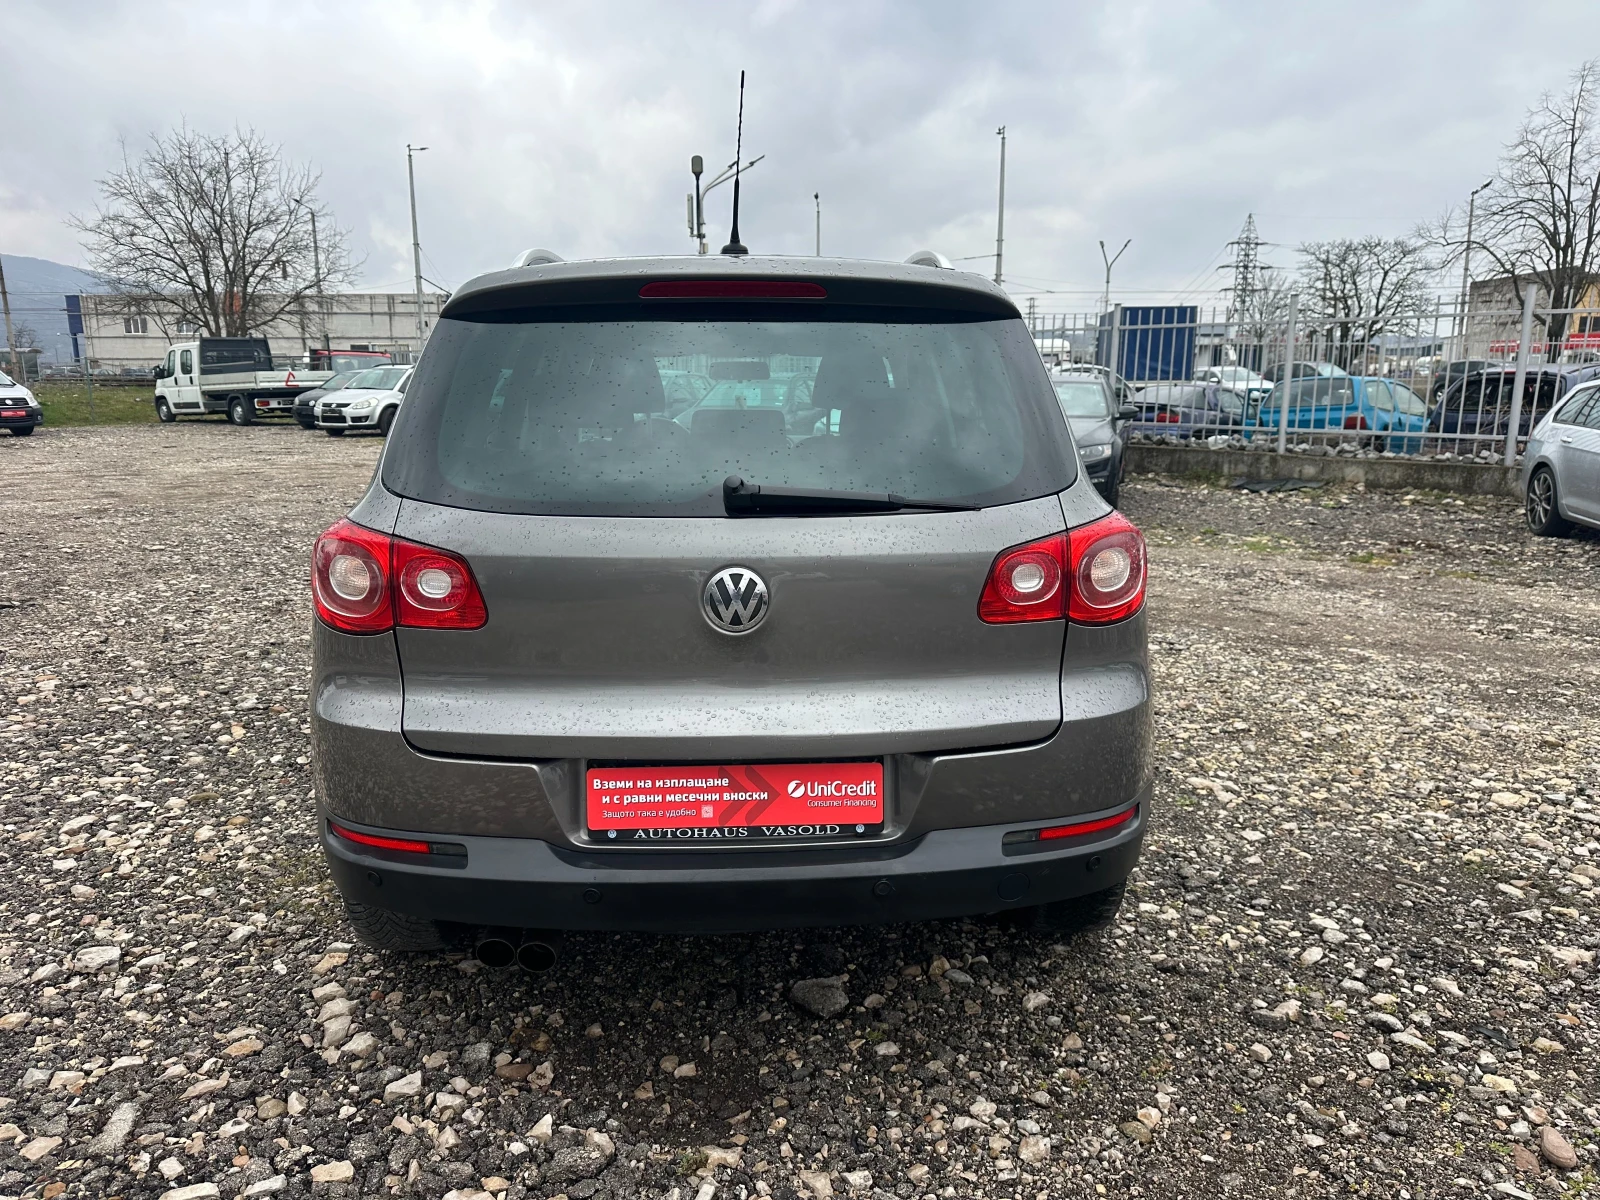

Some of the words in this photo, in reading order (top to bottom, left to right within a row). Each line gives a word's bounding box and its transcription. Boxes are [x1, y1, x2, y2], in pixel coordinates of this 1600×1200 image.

[593, 779, 633, 790] Вземи
[637, 780, 652, 788] на
[656, 778, 729, 788] изплащане
[807, 780, 876, 797] UniCredit
[602, 796, 610, 804] и
[614, 796, 620, 804] с
[624, 794, 662, 806] равни
[666, 792, 720, 802] месечни
[723, 792, 768, 801] вноски
[807, 800, 842, 808] Consumer
[844, 798, 876, 808] Financing
[602, 810, 634, 819] Защото
[636, 810, 656, 818] така
[666, 808, 696, 818] удобно
[634, 828, 748, 838] AUTOHAUS
[761, 825, 840, 836] VASOLD
